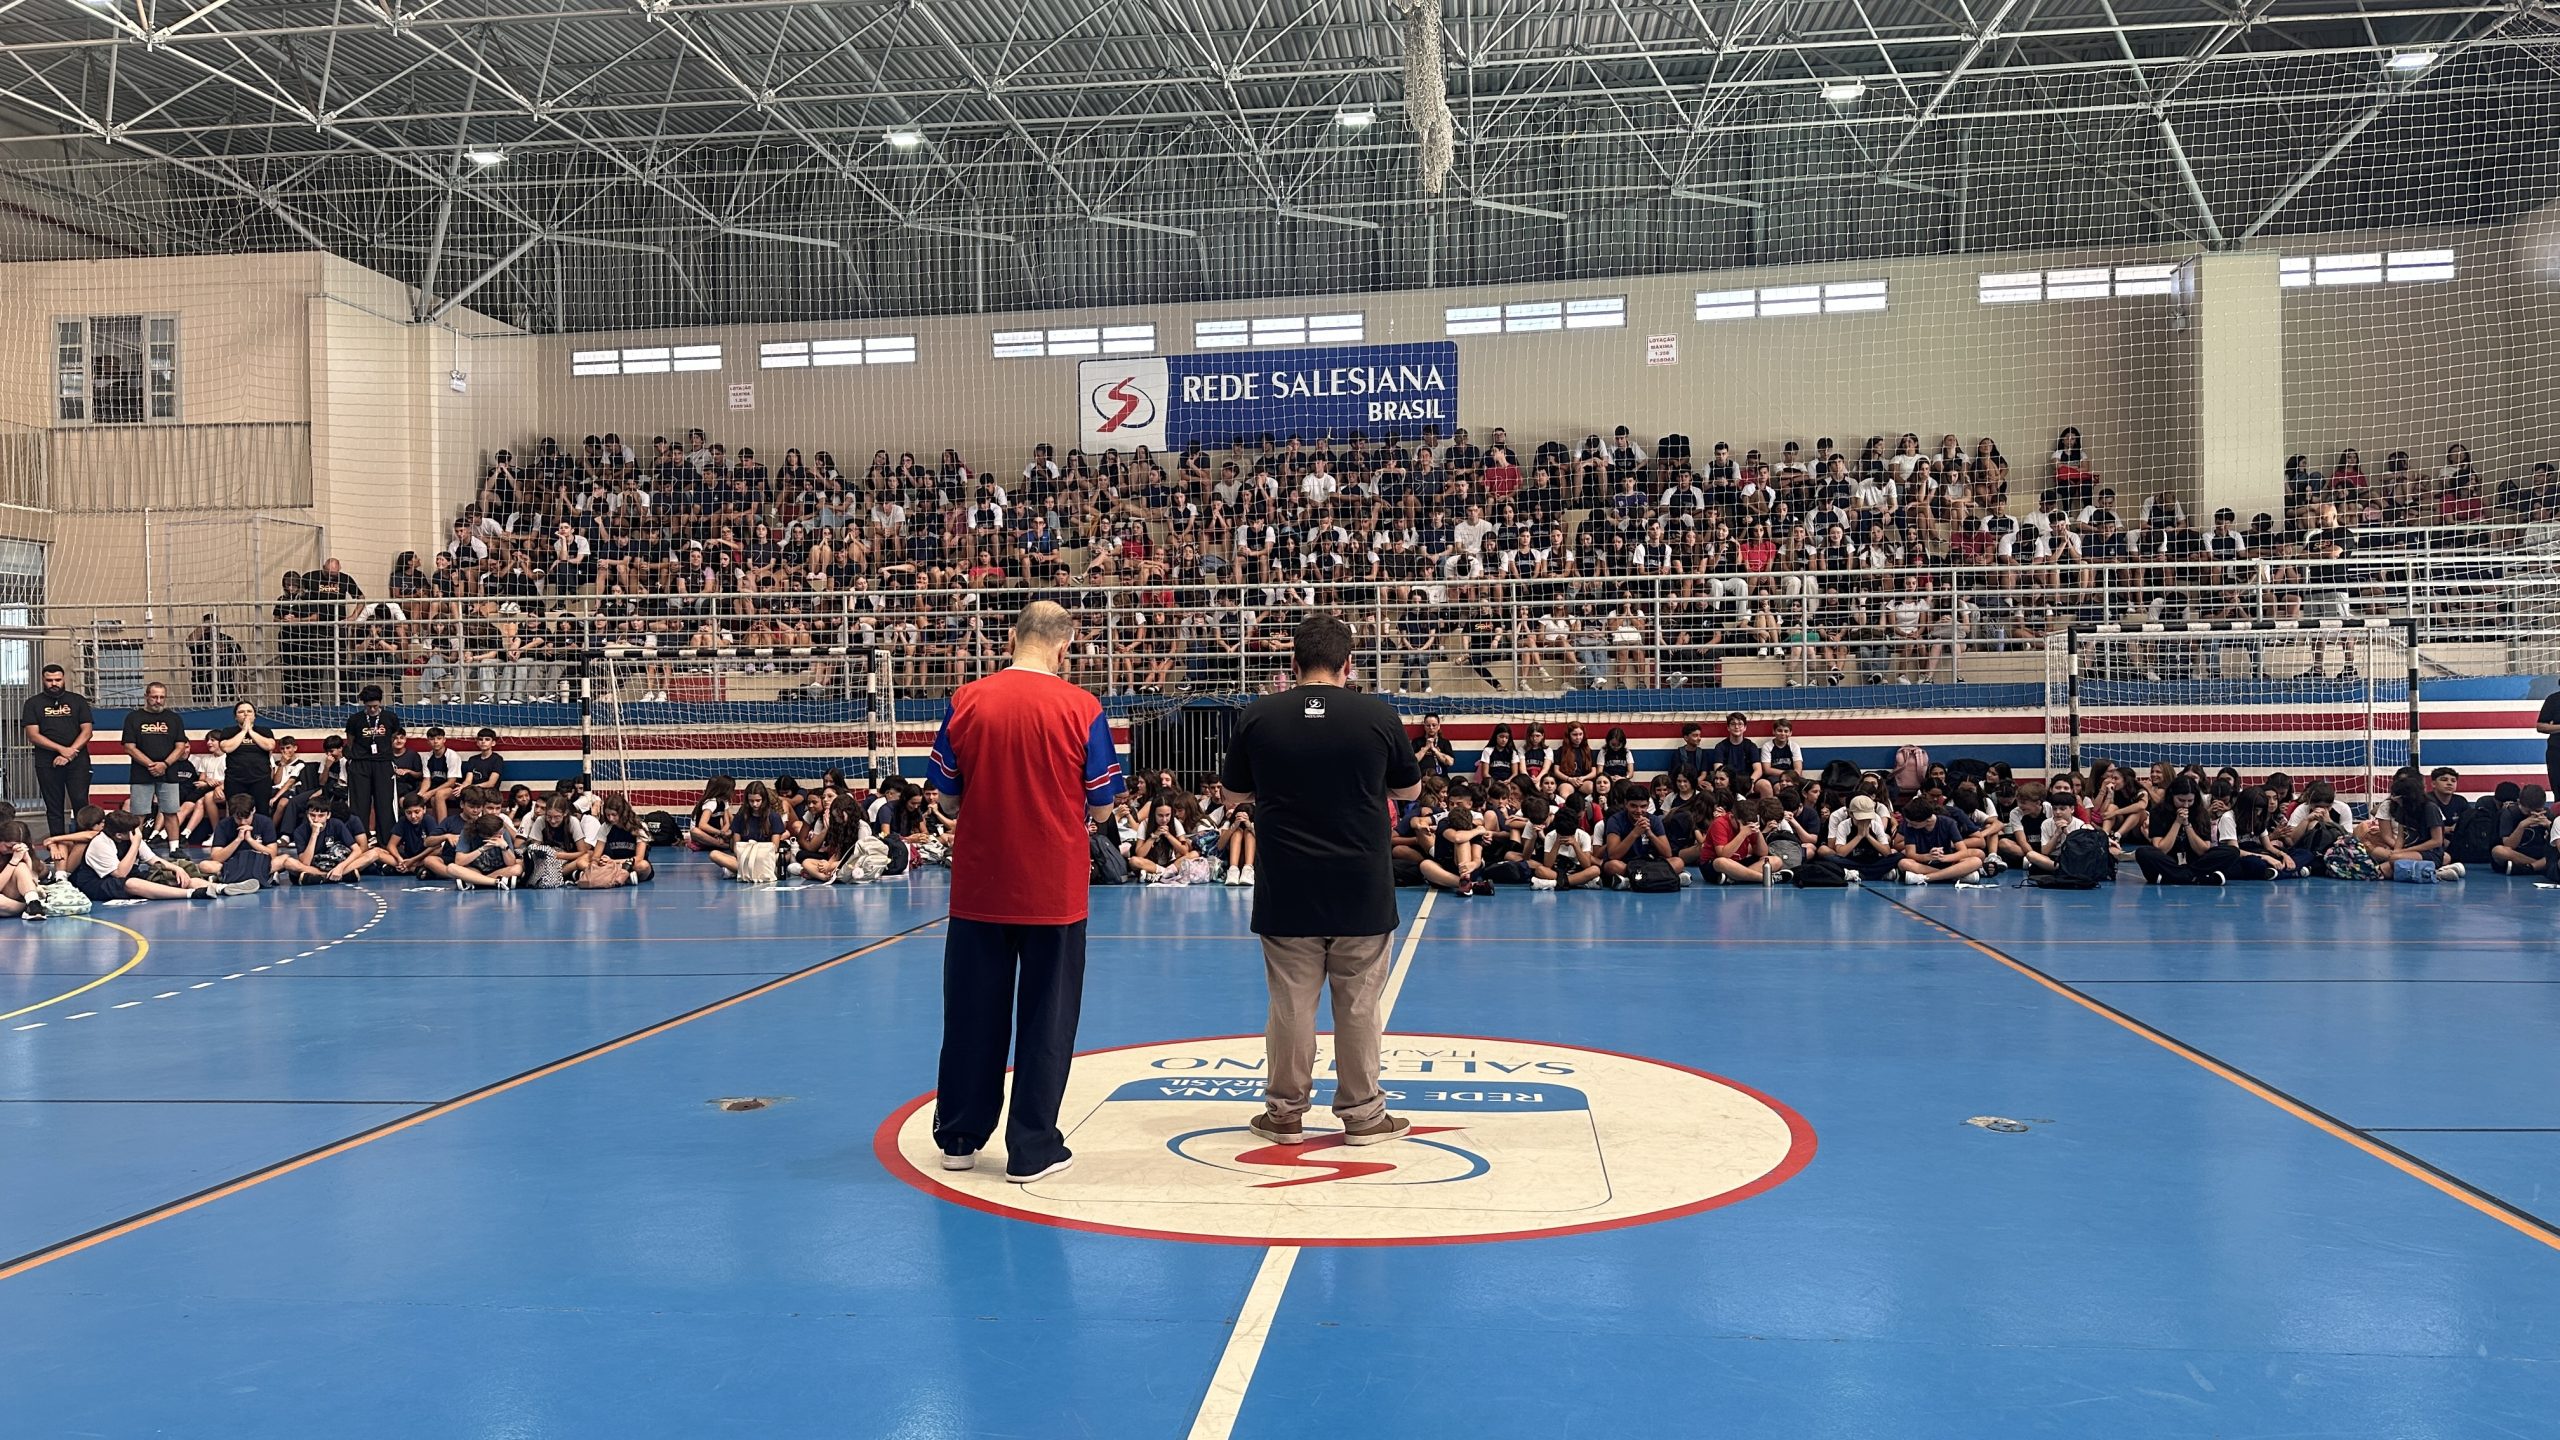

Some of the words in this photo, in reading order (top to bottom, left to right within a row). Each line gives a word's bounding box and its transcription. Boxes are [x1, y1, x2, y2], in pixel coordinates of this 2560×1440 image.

[1183, 372, 1259, 402] REDE
[1271, 365, 1445, 398] SALESIANA
[1369, 398, 1446, 422] BRASIL
[1151, 1057, 1575, 1075] SALEINO
[1424, 1091, 1544, 1103] REDE
